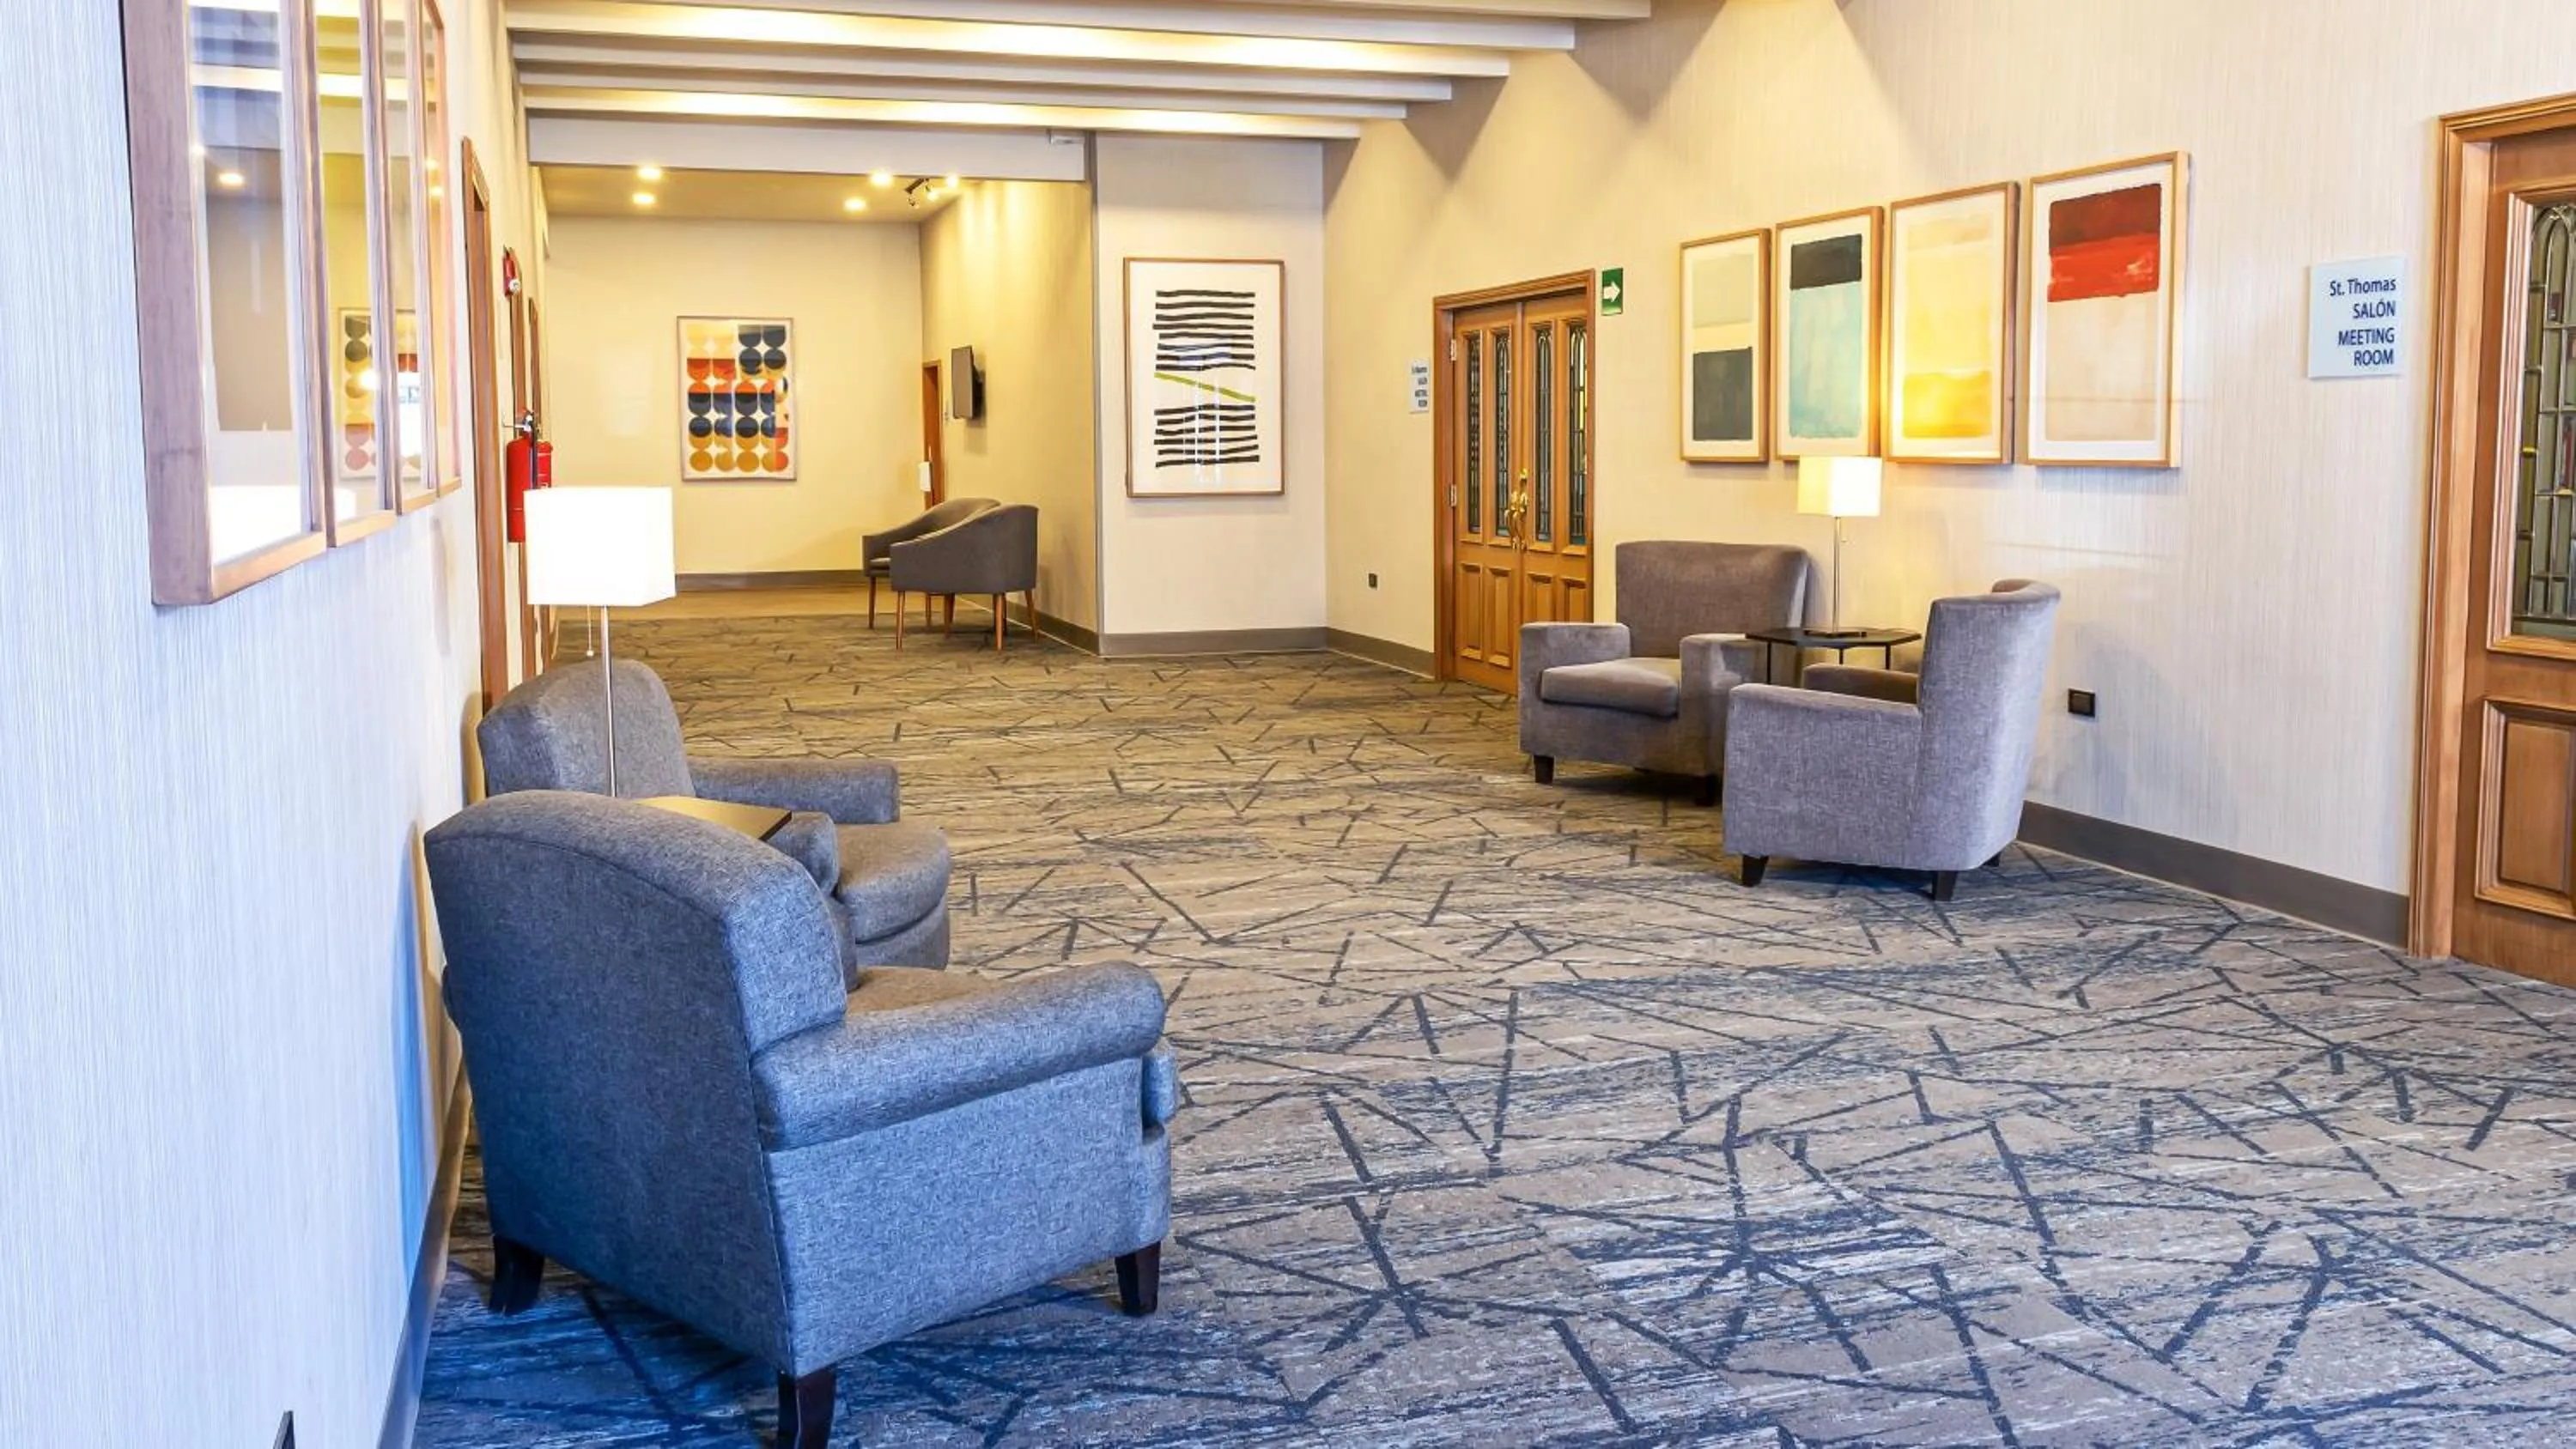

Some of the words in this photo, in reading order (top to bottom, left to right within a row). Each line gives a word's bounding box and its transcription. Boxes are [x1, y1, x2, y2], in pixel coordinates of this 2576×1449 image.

[2330, 280, 2345, 296] St.
[2347, 277, 2397, 294] Thomas
[2353, 298, 2396, 318] SALÓN
[2338, 327, 2395, 346] MEETING
[2354, 349, 2394, 366] ROOM
